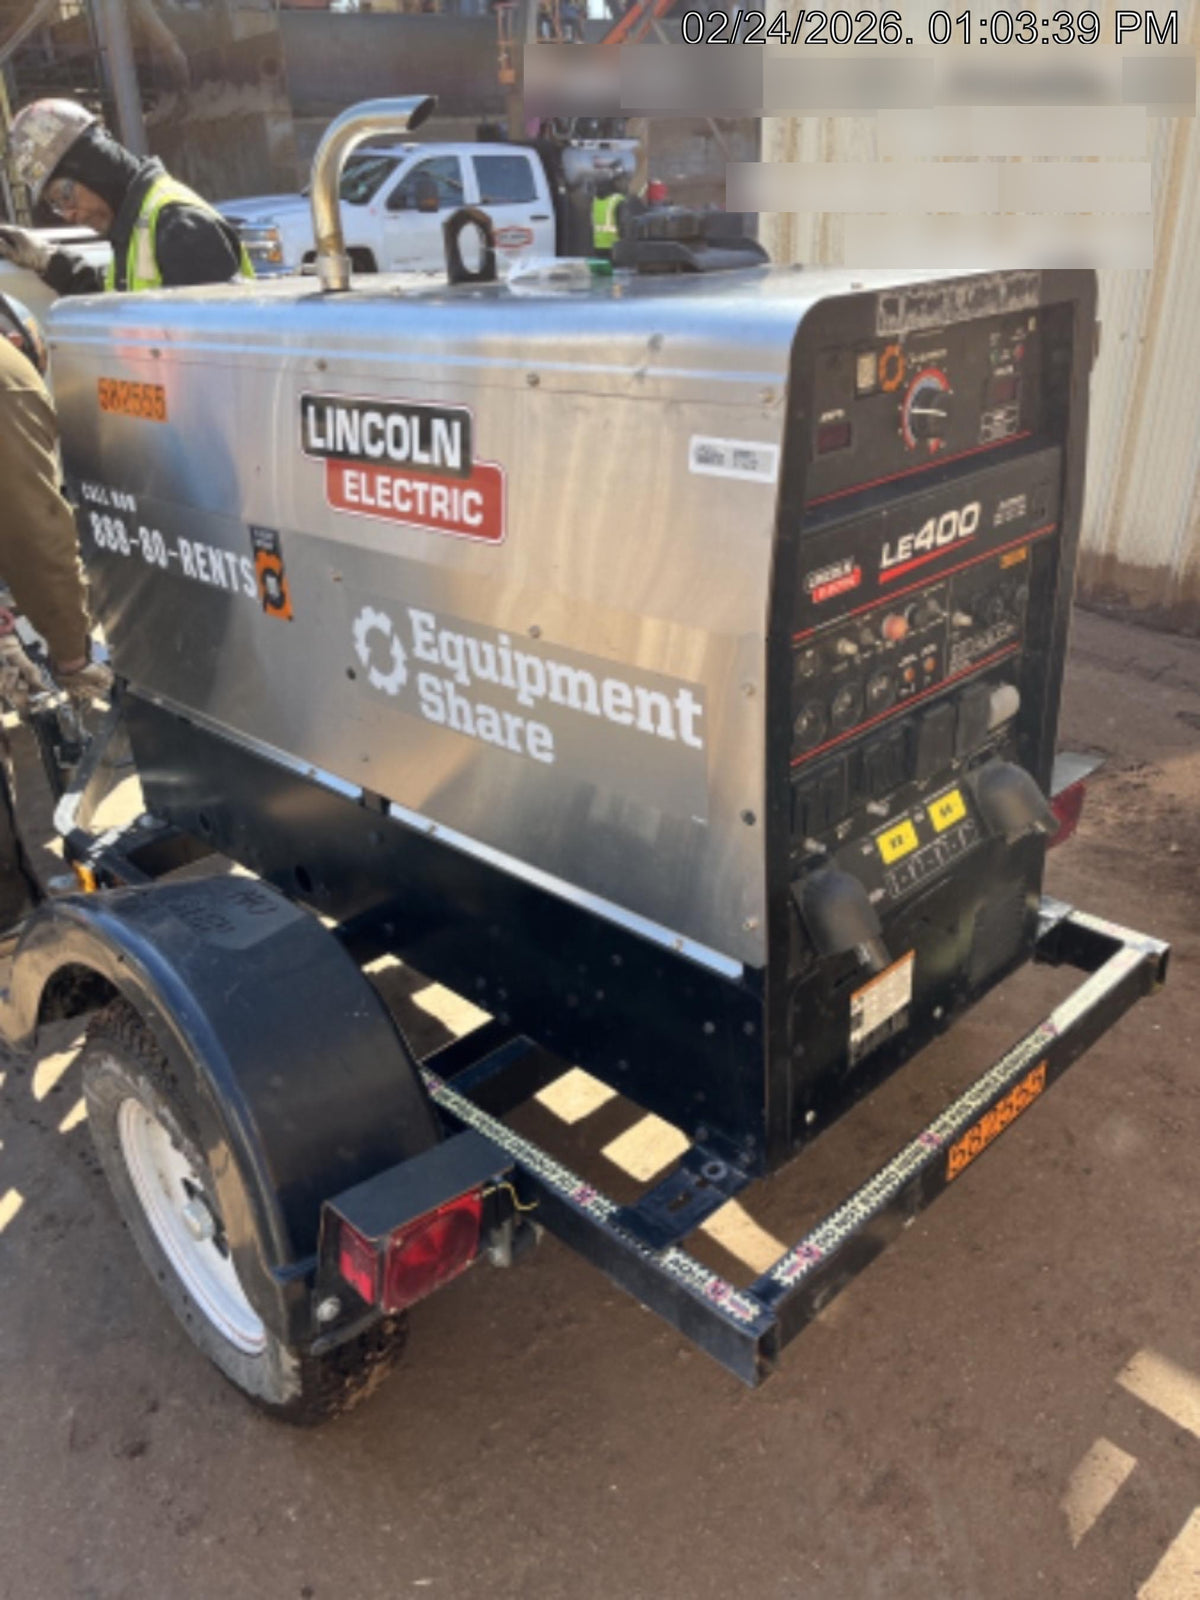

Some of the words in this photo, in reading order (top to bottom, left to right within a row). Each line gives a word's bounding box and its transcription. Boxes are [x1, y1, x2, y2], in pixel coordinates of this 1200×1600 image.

[307, 404, 462, 469] LINCOLN
[343, 470, 483, 526] ELECTRIC
[879, 501, 982, 569] LE400
[89, 511, 257, 598] 888-80-RENTS
[407, 608, 703, 750] Equipment
[416, 672, 556, 764] Share
